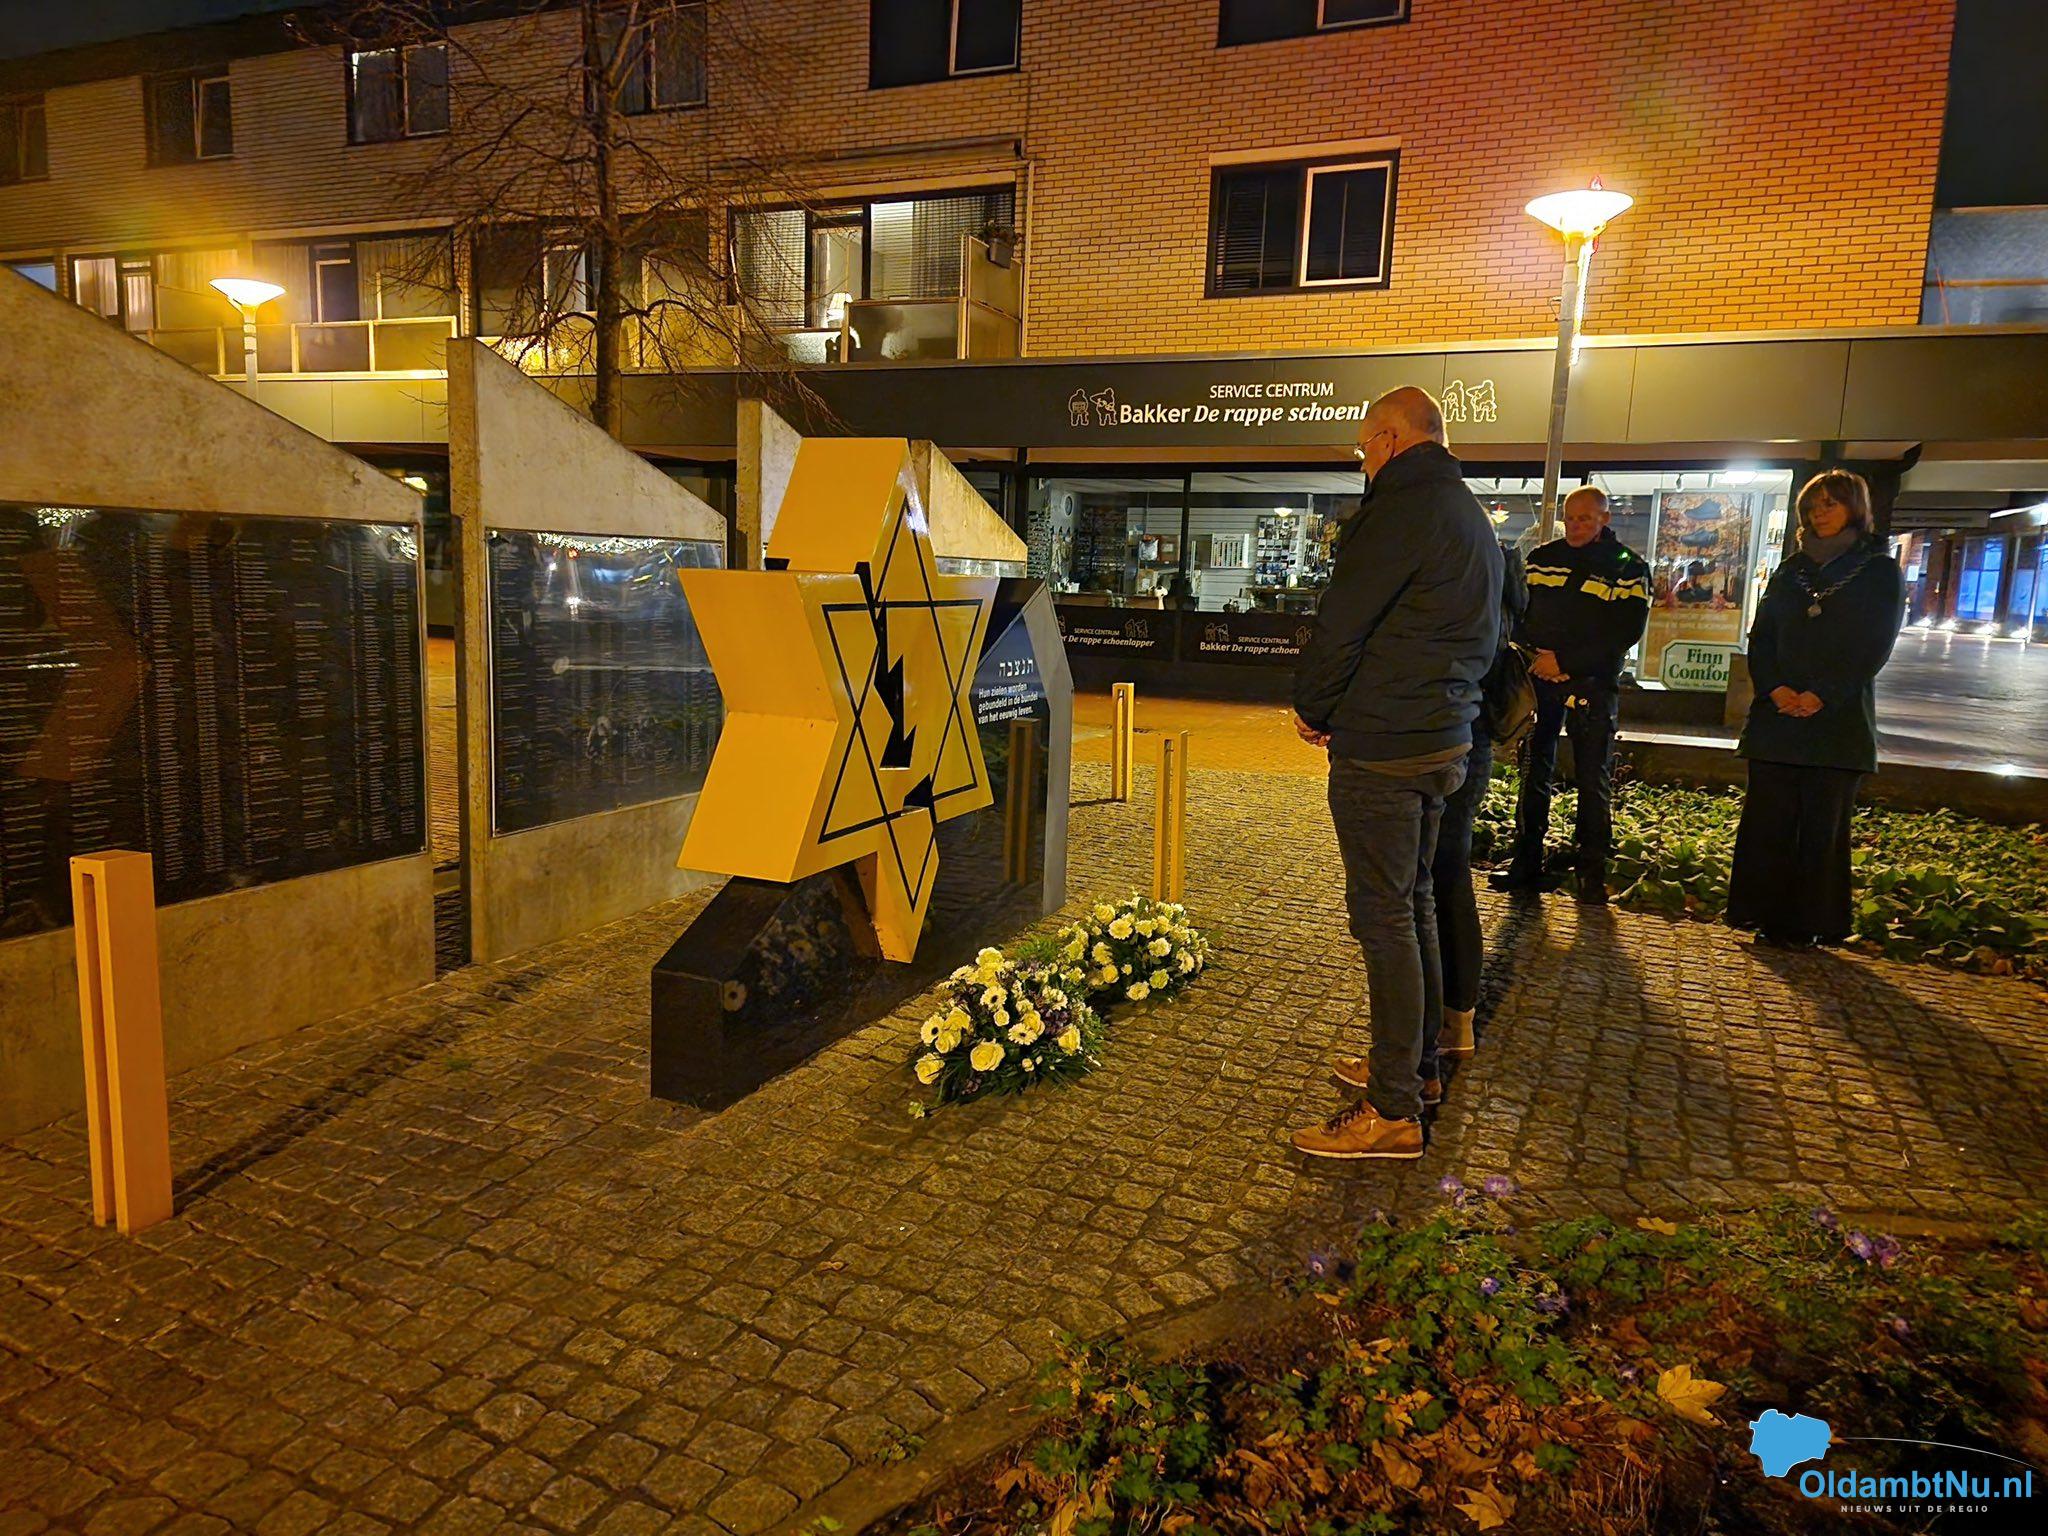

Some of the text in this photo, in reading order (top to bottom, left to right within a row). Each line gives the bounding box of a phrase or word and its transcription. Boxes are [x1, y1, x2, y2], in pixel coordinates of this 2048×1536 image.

[1209, 382, 1334, 399] SERVICE CENTRUM
[1120, 400, 1370, 427] Bakker De rappe schoenl
[1074, 627, 1095, 635] SERVICE
[1068, 634, 1079, 643] De
[1079, 635, 1102, 646] rappe
[1102, 637, 1155, 648] schoenlapper
[1200, 641, 1300, 655] Bakker De rappe schoen
[1260, 637, 1290, 645] CENTRUM
[1686, 648, 1723, 665] Finn
[1669, 664, 1729, 681] Comfor
[978, 691, 1038, 714] gebundeld in de bundel
[978, 715, 988, 725] van
[989, 712, 998, 722] het
[999, 708, 1017, 720] eeuwig
